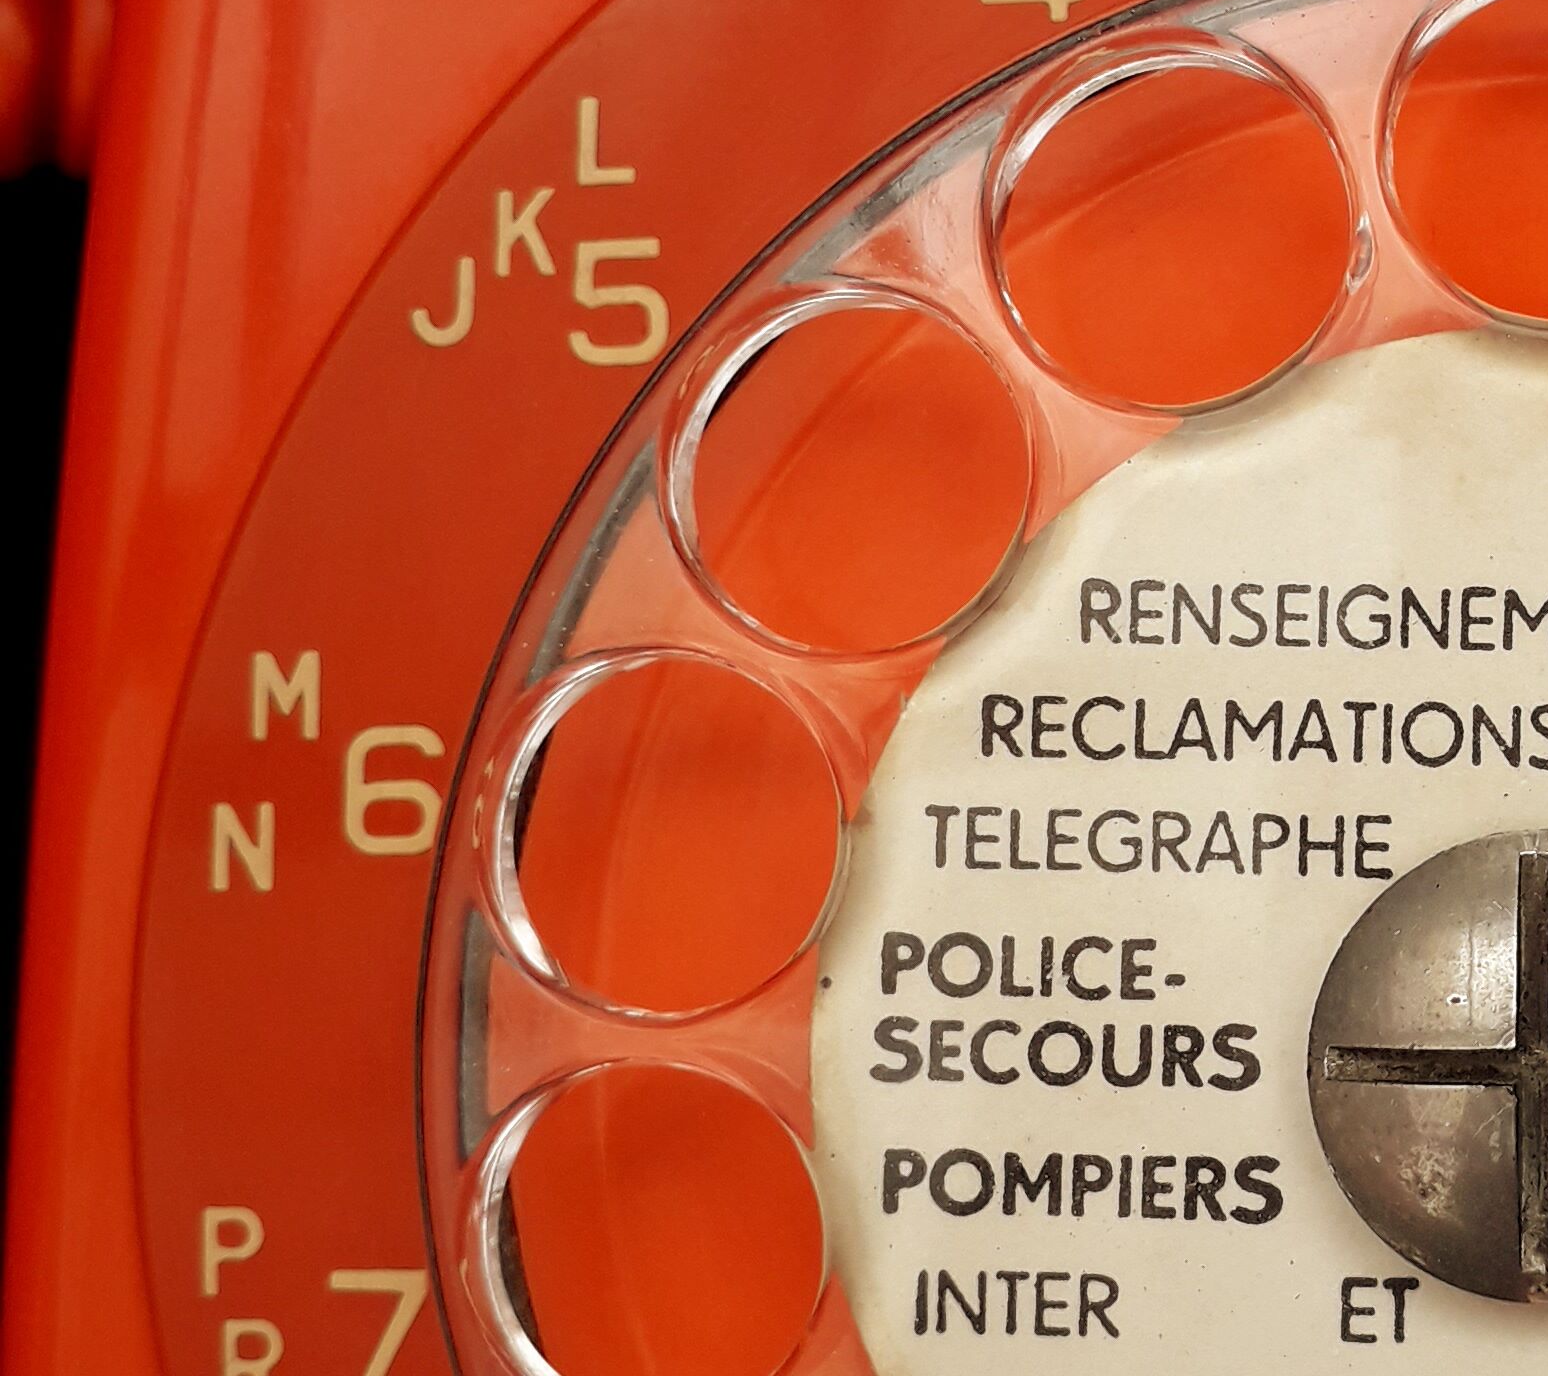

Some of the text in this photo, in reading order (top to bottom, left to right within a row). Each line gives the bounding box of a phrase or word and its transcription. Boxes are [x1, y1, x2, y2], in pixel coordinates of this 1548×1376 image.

[568, 237, 670, 367] 5
[344, 724, 445, 856] 6
[924, 803, 1394, 881] TELEGRAPHE
[880, 930, 1187, 1003] POLICE-
[869, 1014, 1262, 1093] SECOURS
[882, 1147, 1285, 1226] POMPIERS
[912, 1268, 1121, 1340] INTER
[1339, 1275, 1422, 1345] ET
